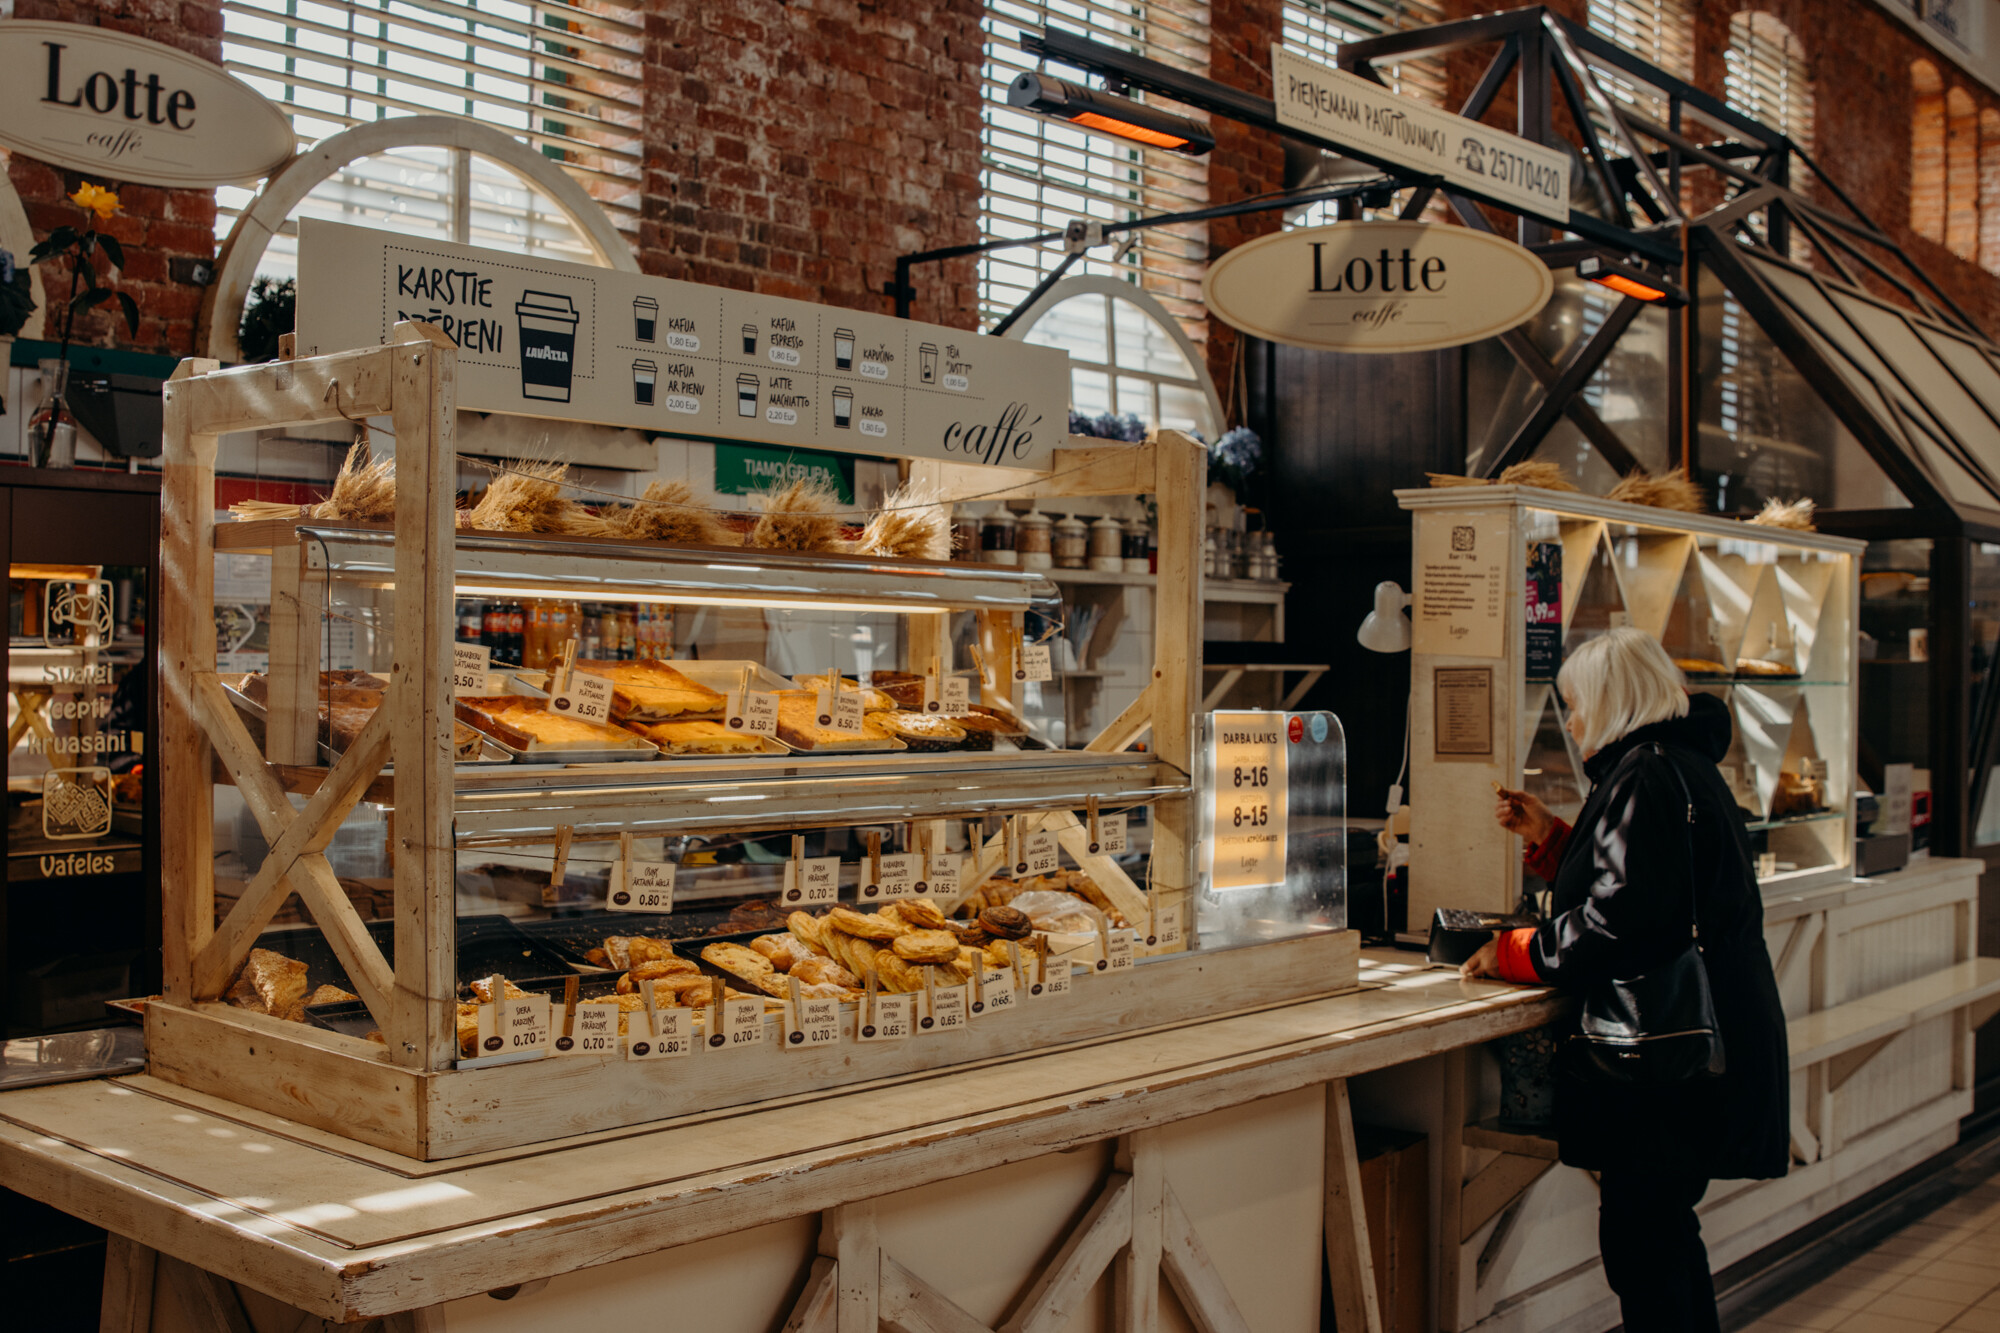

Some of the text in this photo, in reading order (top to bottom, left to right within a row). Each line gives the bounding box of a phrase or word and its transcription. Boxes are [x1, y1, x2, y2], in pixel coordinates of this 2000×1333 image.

[40, 41, 196, 131] Lotte
[1288, 74, 1361, 125] PIEŅEMAM
[86, 128, 143, 160] caffé
[1489, 147, 1560, 199] 25770420
[1307, 242, 1447, 292] Lotte
[398, 264, 493, 307] KARSTIE
[1351, 301, 1407, 331] caffé
[398, 308, 503, 354] RIENI
[770, 334, 804, 349] ESPRESSO
[669, 336, 698, 348] 1,80 Eur
[525, 345, 568, 363] LAVAZZA
[784, 352, 798, 364] Eur
[875, 365, 887, 377] Eur
[667, 380, 705, 396] AR PIENU
[769, 377, 793, 391] LATTE
[669, 398, 698, 411] 2,00 Eur
[769, 394, 810, 408] MACHIATTO
[861, 405, 883, 418] KAKAO
[768, 409, 795, 422] 2,20 Eur
[874, 423, 885, 434] Eur
[943, 401, 1042, 465] caffé
[744, 458, 785, 479] TIAMO
[43, 662, 113, 685] Svaigi
[51, 697, 105, 720] cepti
[28, 731, 126, 755] kruasāni
[1223, 733, 1251, 744] DARBA
[1253, 733, 1277, 744] LAIKS
[40, 853, 114, 878] Vafeles
